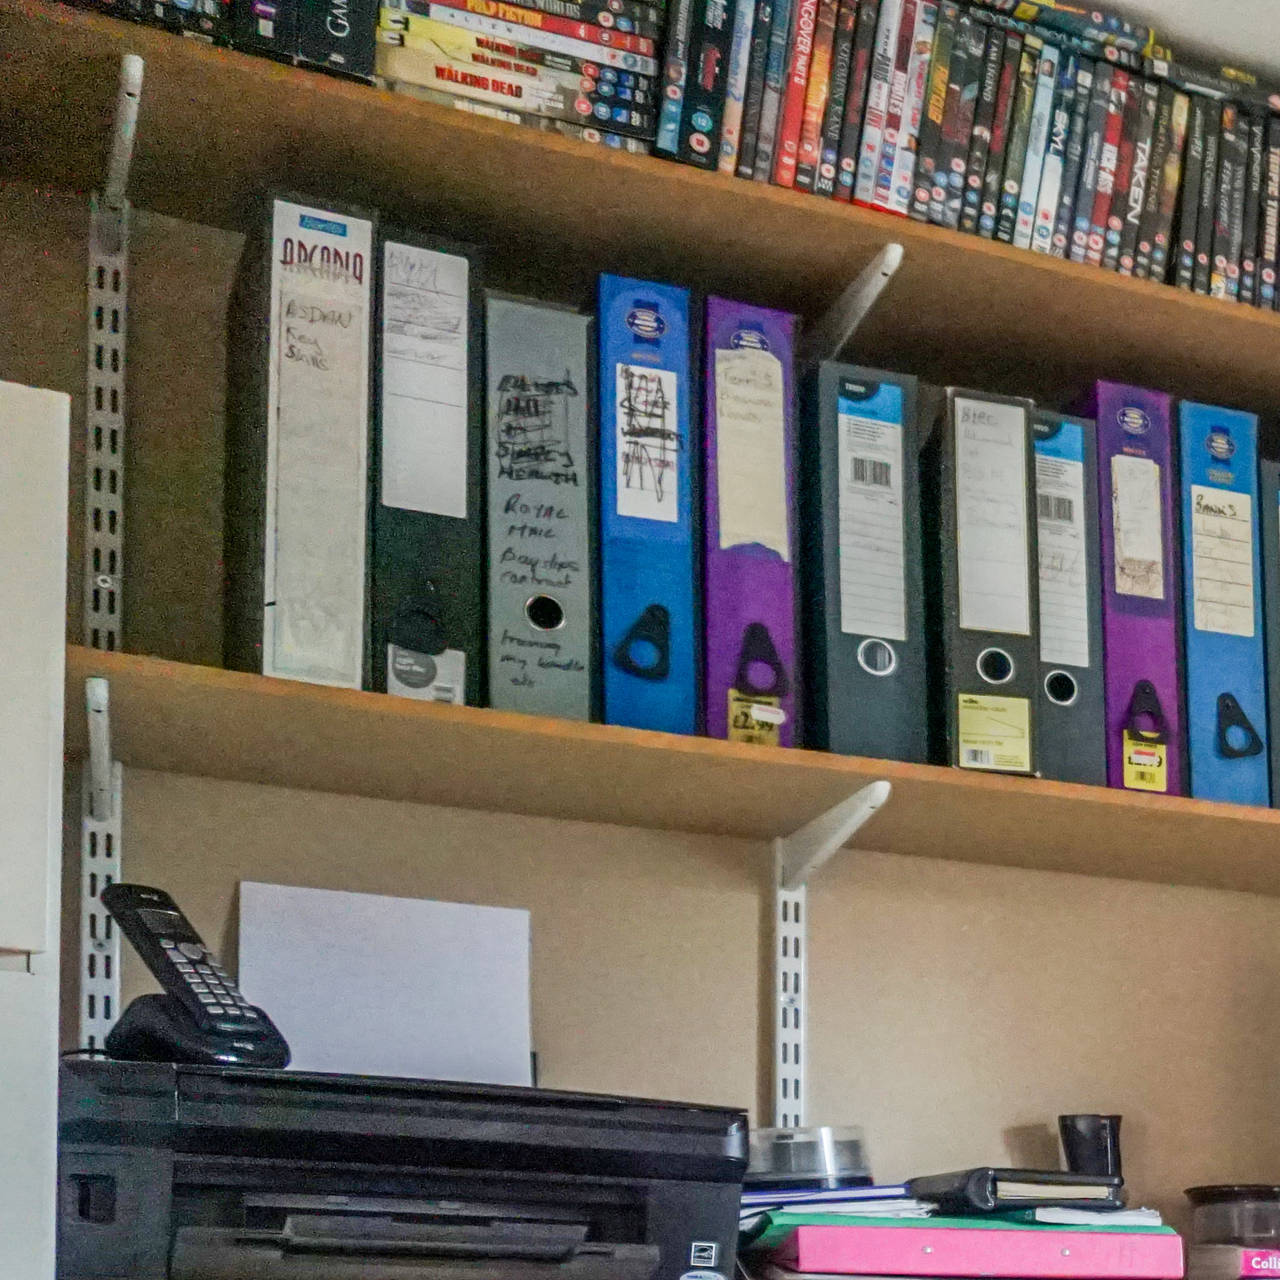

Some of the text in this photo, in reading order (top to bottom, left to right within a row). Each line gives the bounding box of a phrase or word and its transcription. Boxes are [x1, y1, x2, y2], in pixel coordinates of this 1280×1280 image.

[434, 64, 523, 98] WALKING DEAD
[1126, 137, 1151, 225] TAKEN
